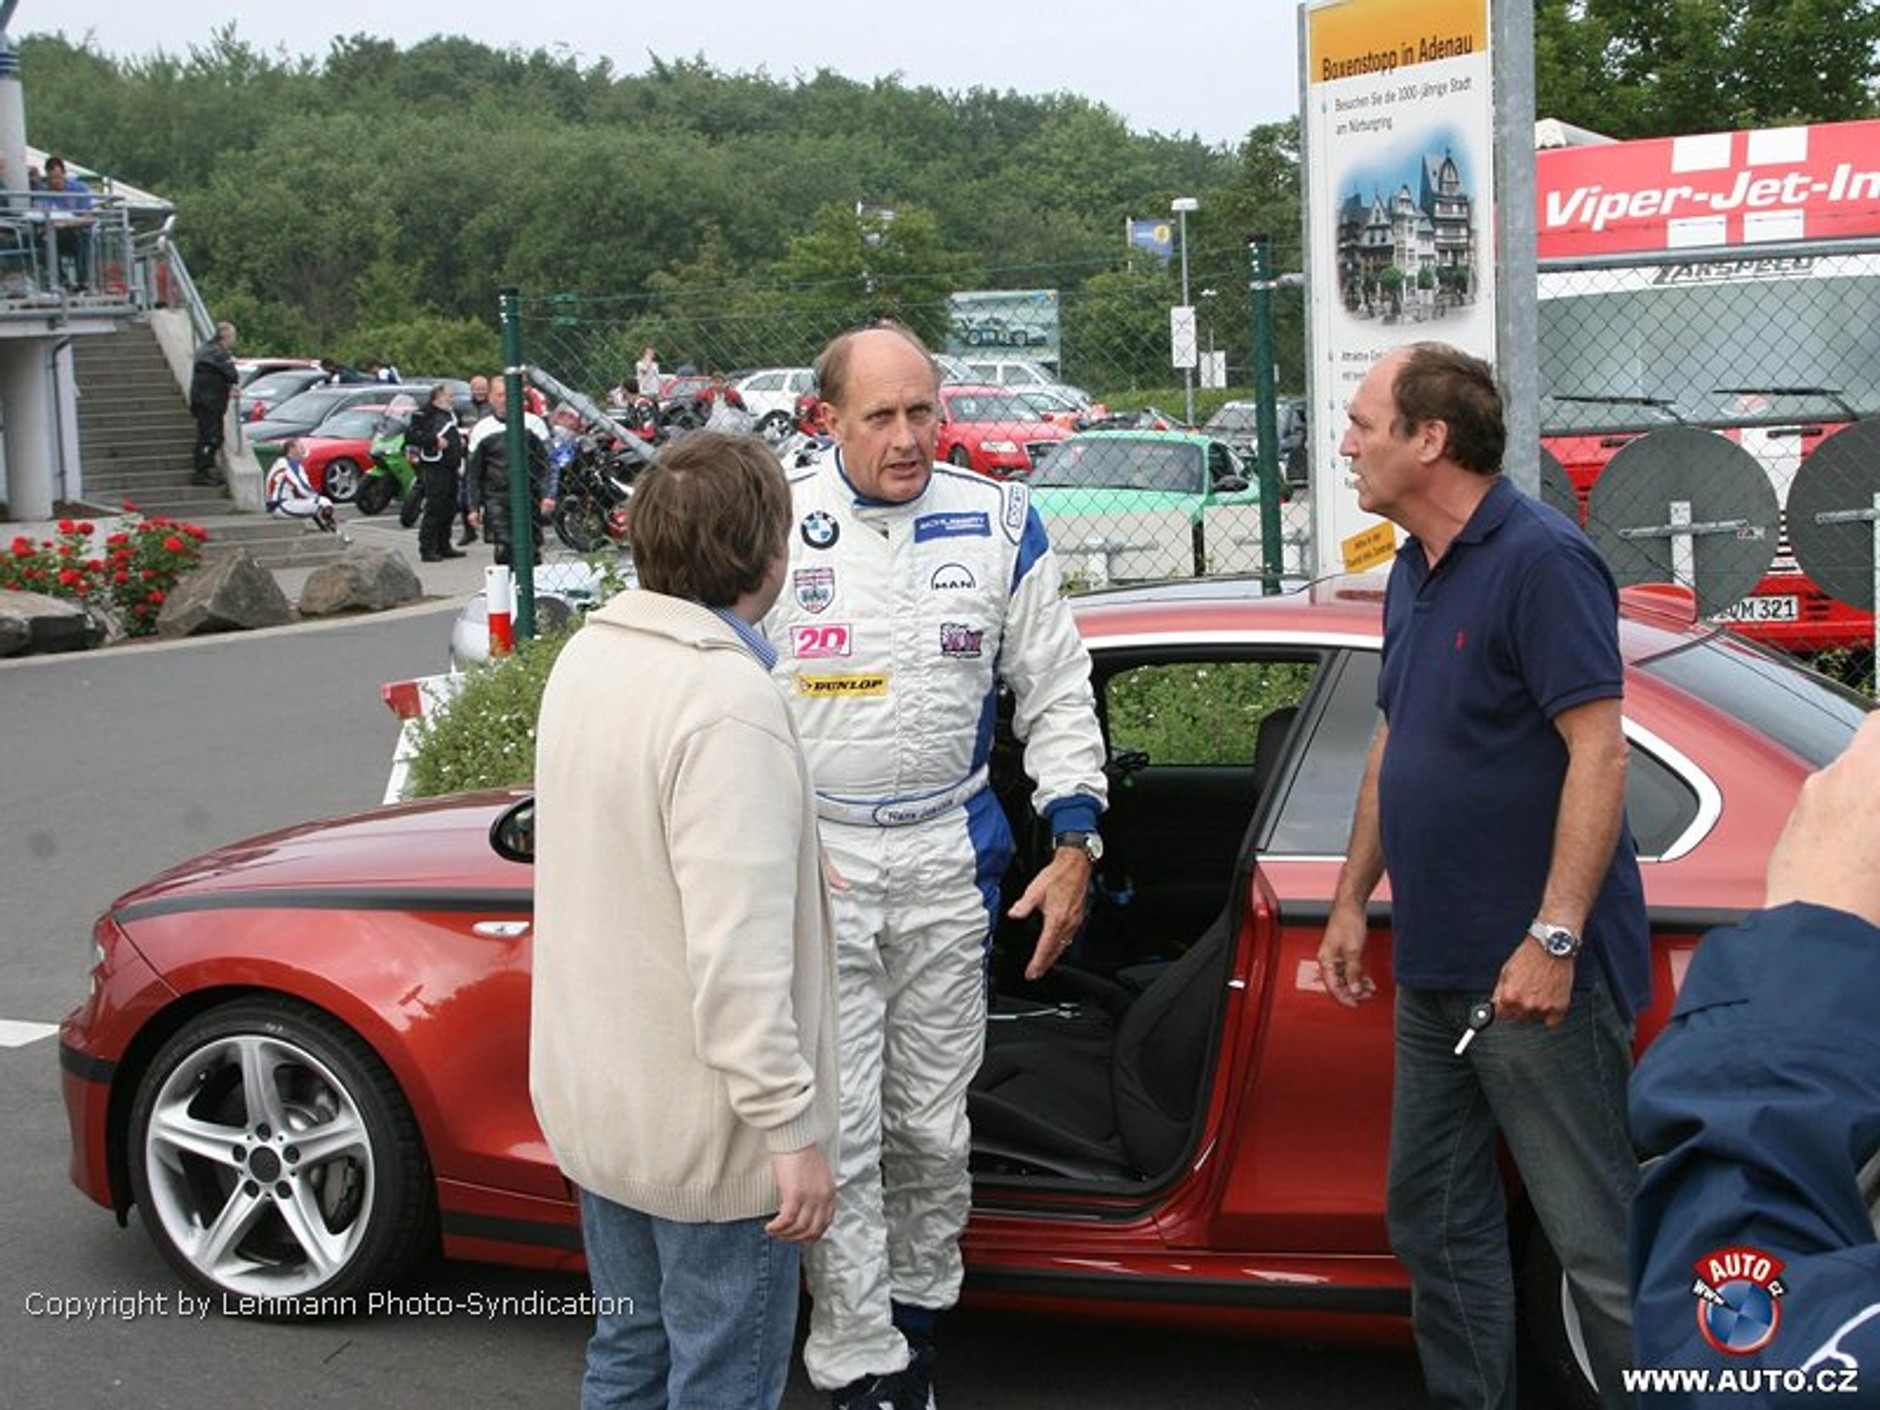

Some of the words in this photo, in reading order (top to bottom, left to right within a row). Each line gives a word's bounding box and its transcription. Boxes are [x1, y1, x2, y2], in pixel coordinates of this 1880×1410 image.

[1322, 49, 1397, 81] Boxenstopp
[1401, 42, 1414, 67] in
[1418, 34, 1473, 63] Adenau
[1371, 91, 1383, 106] Sie
[1384, 88, 1396, 104] die
[1450, 76, 1472, 94] Stadt
[1546, 163, 1880, 232] Viper-Jet-In
[934, 580, 972, 590] MAN
[1760, 599, 1795, 619] 321
[813, 679, 883, 691] DUNLOP
